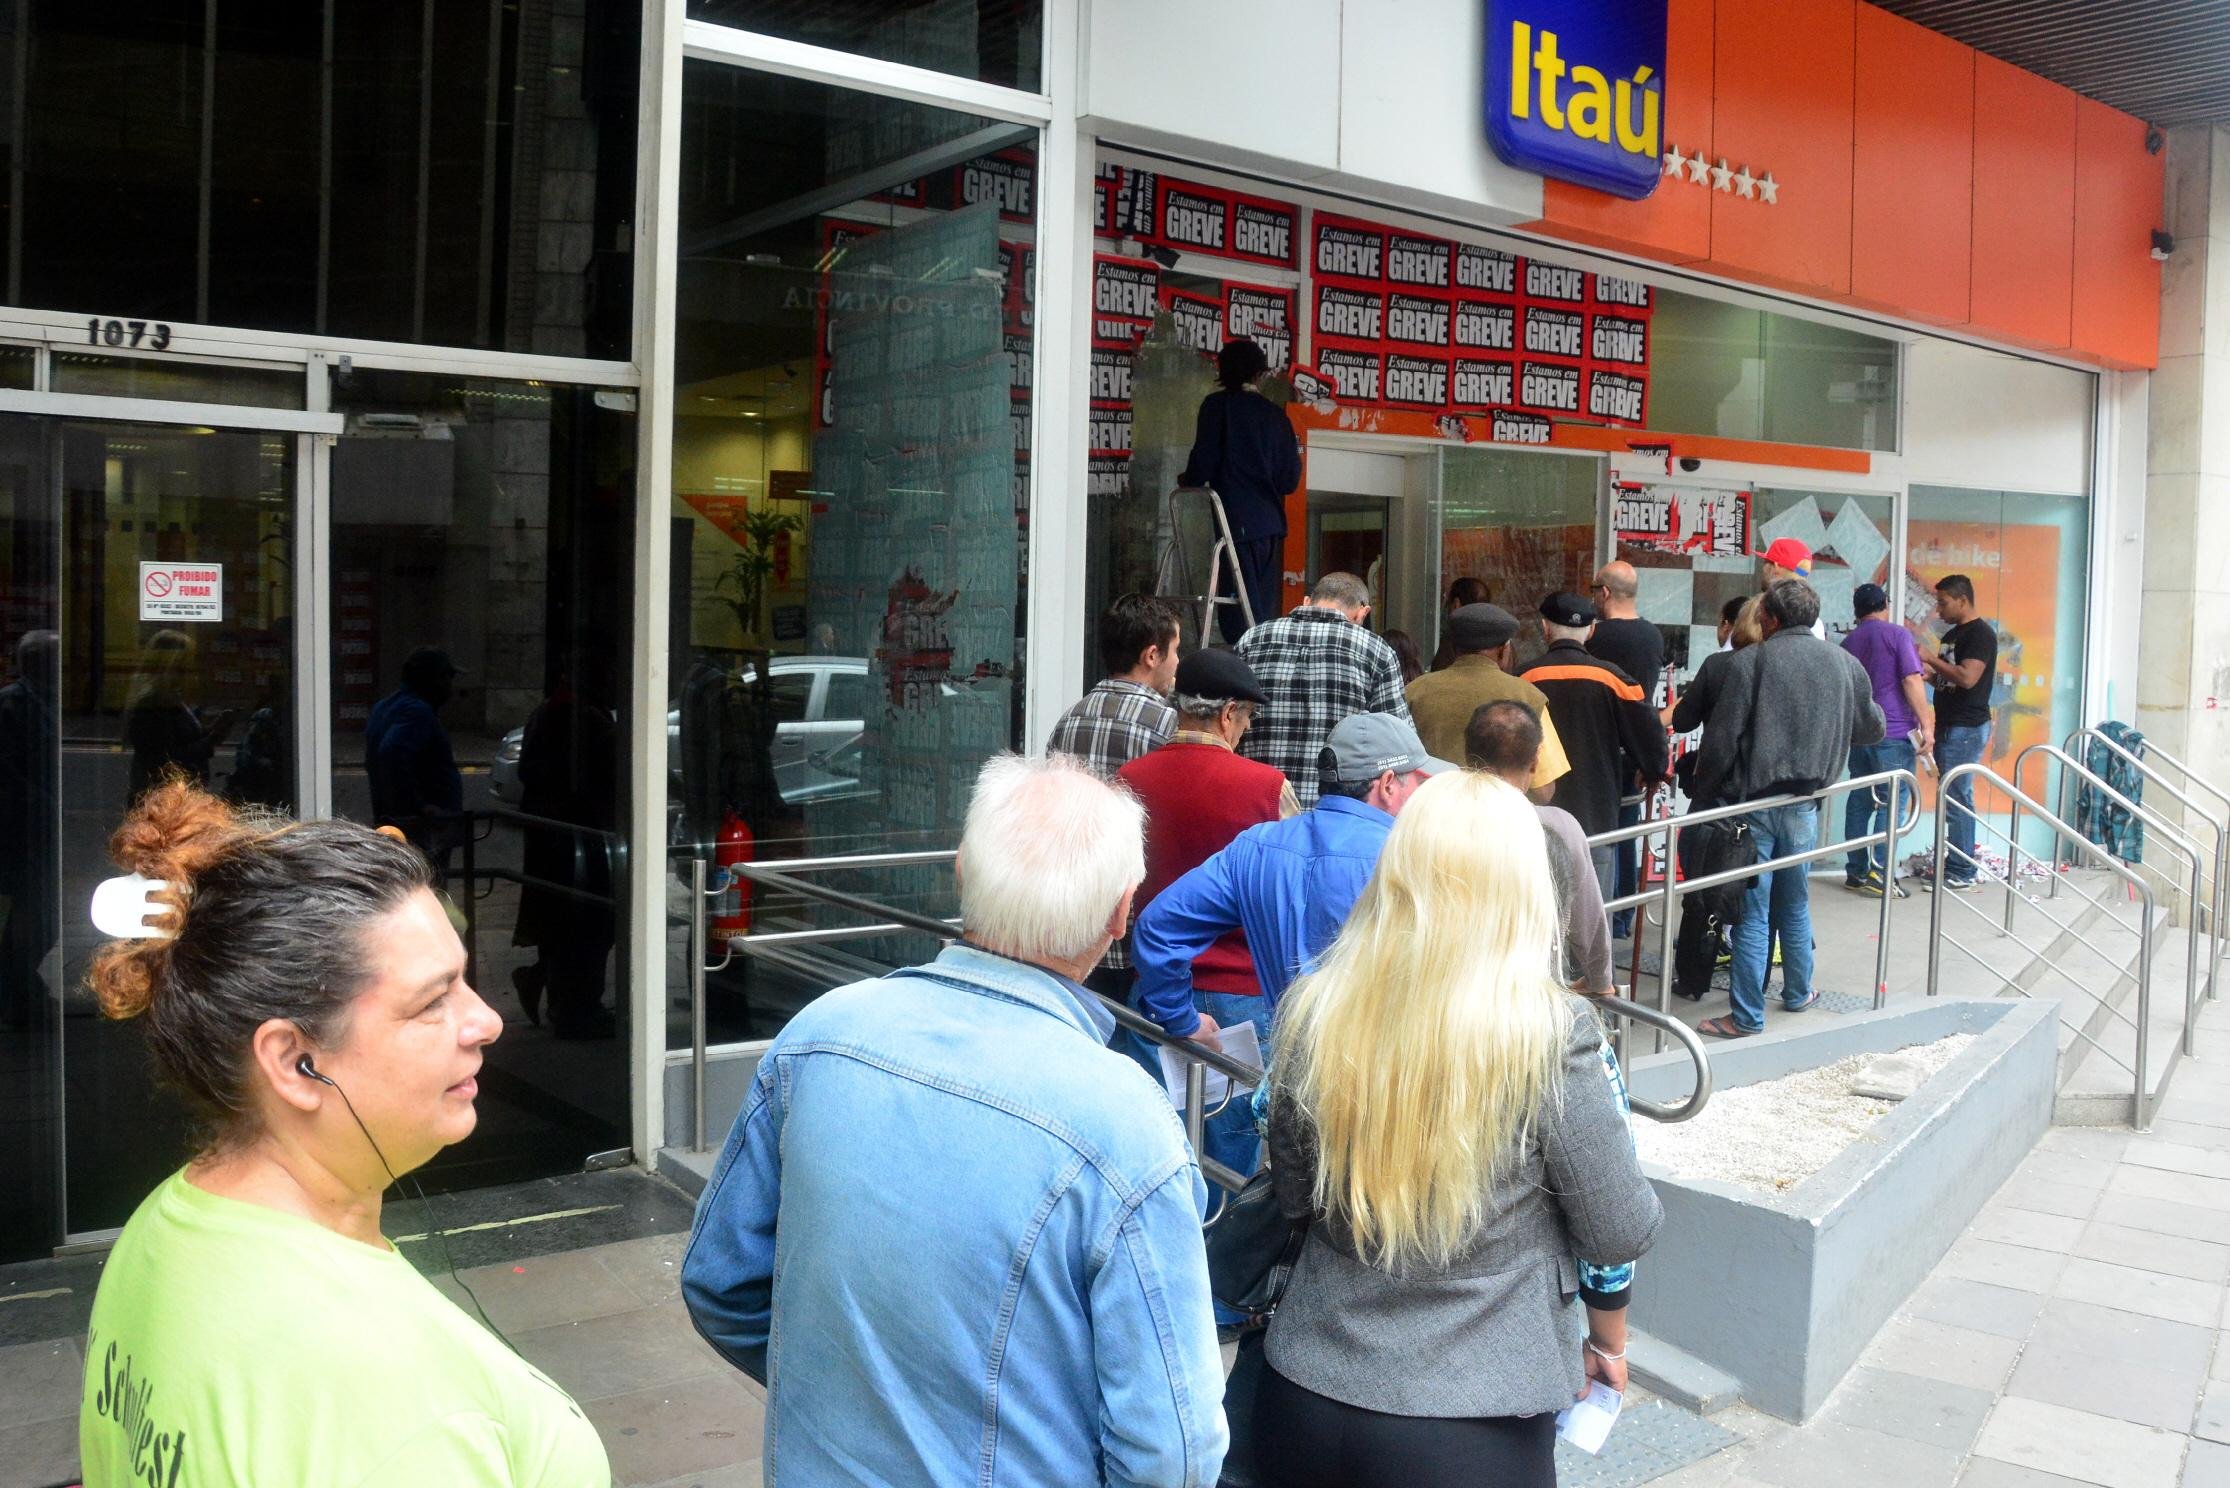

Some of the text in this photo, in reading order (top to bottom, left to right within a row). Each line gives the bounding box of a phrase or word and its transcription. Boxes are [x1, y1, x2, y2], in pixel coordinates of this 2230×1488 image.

[1511, 19, 1660, 159] Itaú
[1167, 191, 1224, 215] Estamos em
[1236, 203, 1290, 227] Estamos em
[1166, 205, 1223, 248] GREVE
[1235, 218, 1289, 259] GREVE
[1320, 226, 1381, 247] Estamos em
[1390, 236, 1448, 255] Estamos em
[1318, 241, 1380, 278] GREVE
[1388, 249, 1448, 286] GREVE
[1097, 263, 1156, 284] Estamos em
[1456, 254, 1514, 292] GREVE
[1526, 265, 1582, 300] GREVE
[1096, 277, 1156, 318] GREVE
[1173, 296, 1213, 317] Estamos
[1230, 289, 1284, 308] Estamos em
[1321, 287, 1382, 308] Estamos em
[1390, 294, 1449, 313] Estamos em
[1457, 300, 1513, 318] Estamos em
[1319, 301, 1381, 338] GREVE
[1388, 308, 1448, 344] GREVE
[1527, 307, 1582, 326] Estamos em
[1630, 323, 1644, 333] em
[88, 318, 171, 350] 1073
[1455, 314, 1513, 348] GREVE
[1525, 320, 1581, 355] GREVE
[1320, 349, 1364, 367] Estamos
[1388, 355, 1447, 373] Estamos em
[1455, 359, 1512, 374] Estamos em
[1523, 362, 1578, 380] Estamos em
[1090, 364, 1131, 399] REVE
[1386, 369, 1446, 404] GREVE
[1454, 372, 1512, 405] GREVE
[1522, 375, 1578, 410] GREVE
[1629, 381, 1643, 391] em
[1088, 422, 1132, 450] REVE
[1616, 500, 1669, 531] GREVE
[172, 571, 217, 582] PROIBIDO
[179, 586, 211, 596] FUMAR
